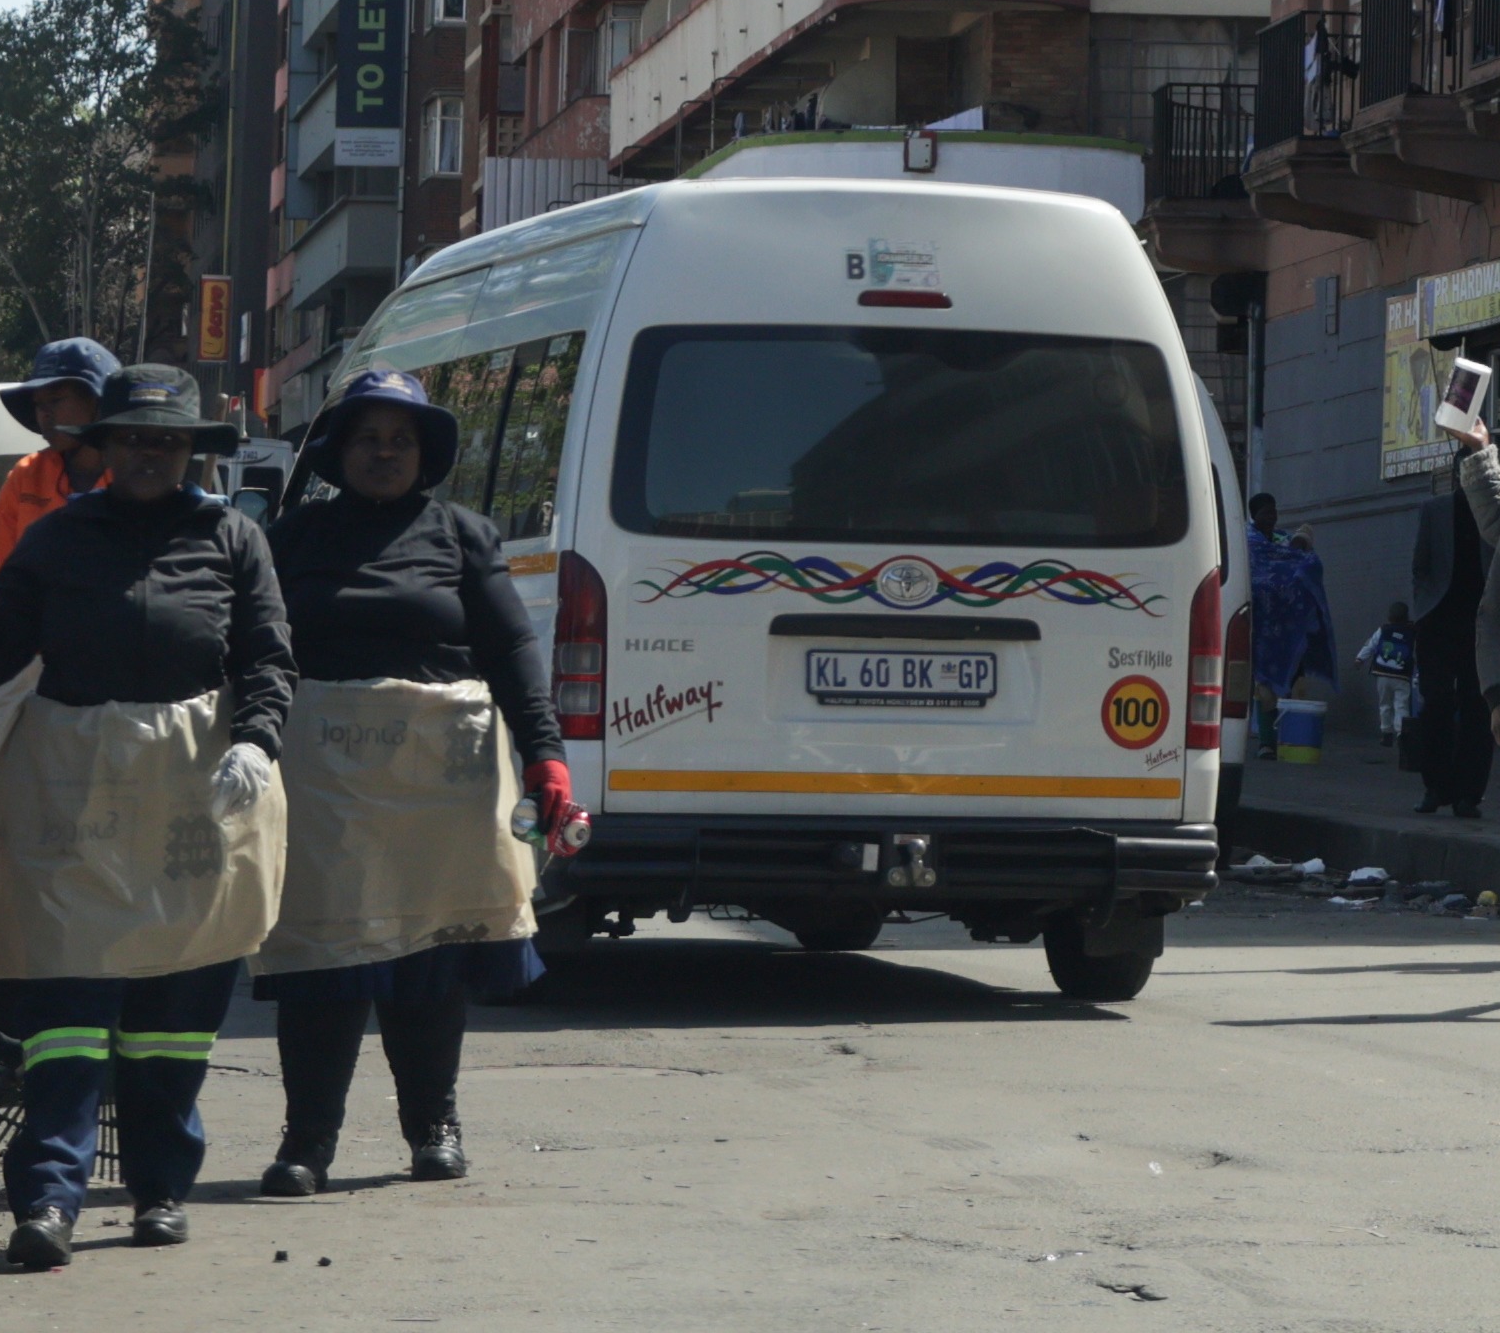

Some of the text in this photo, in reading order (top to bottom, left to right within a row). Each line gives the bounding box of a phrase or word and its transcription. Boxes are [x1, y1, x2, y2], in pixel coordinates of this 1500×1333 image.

[356, 63, 385, 113] TO
[846, 253, 865, 280] B
[1434, 276, 1449, 307] PR
[1389, 303, 1402, 332] PR
[624, 638, 695, 652] HIACE
[816, 656, 989, 690] KL 60 BK GP
[610, 681, 722, 736] Halfway
[1112, 697, 1159, 727] 100
